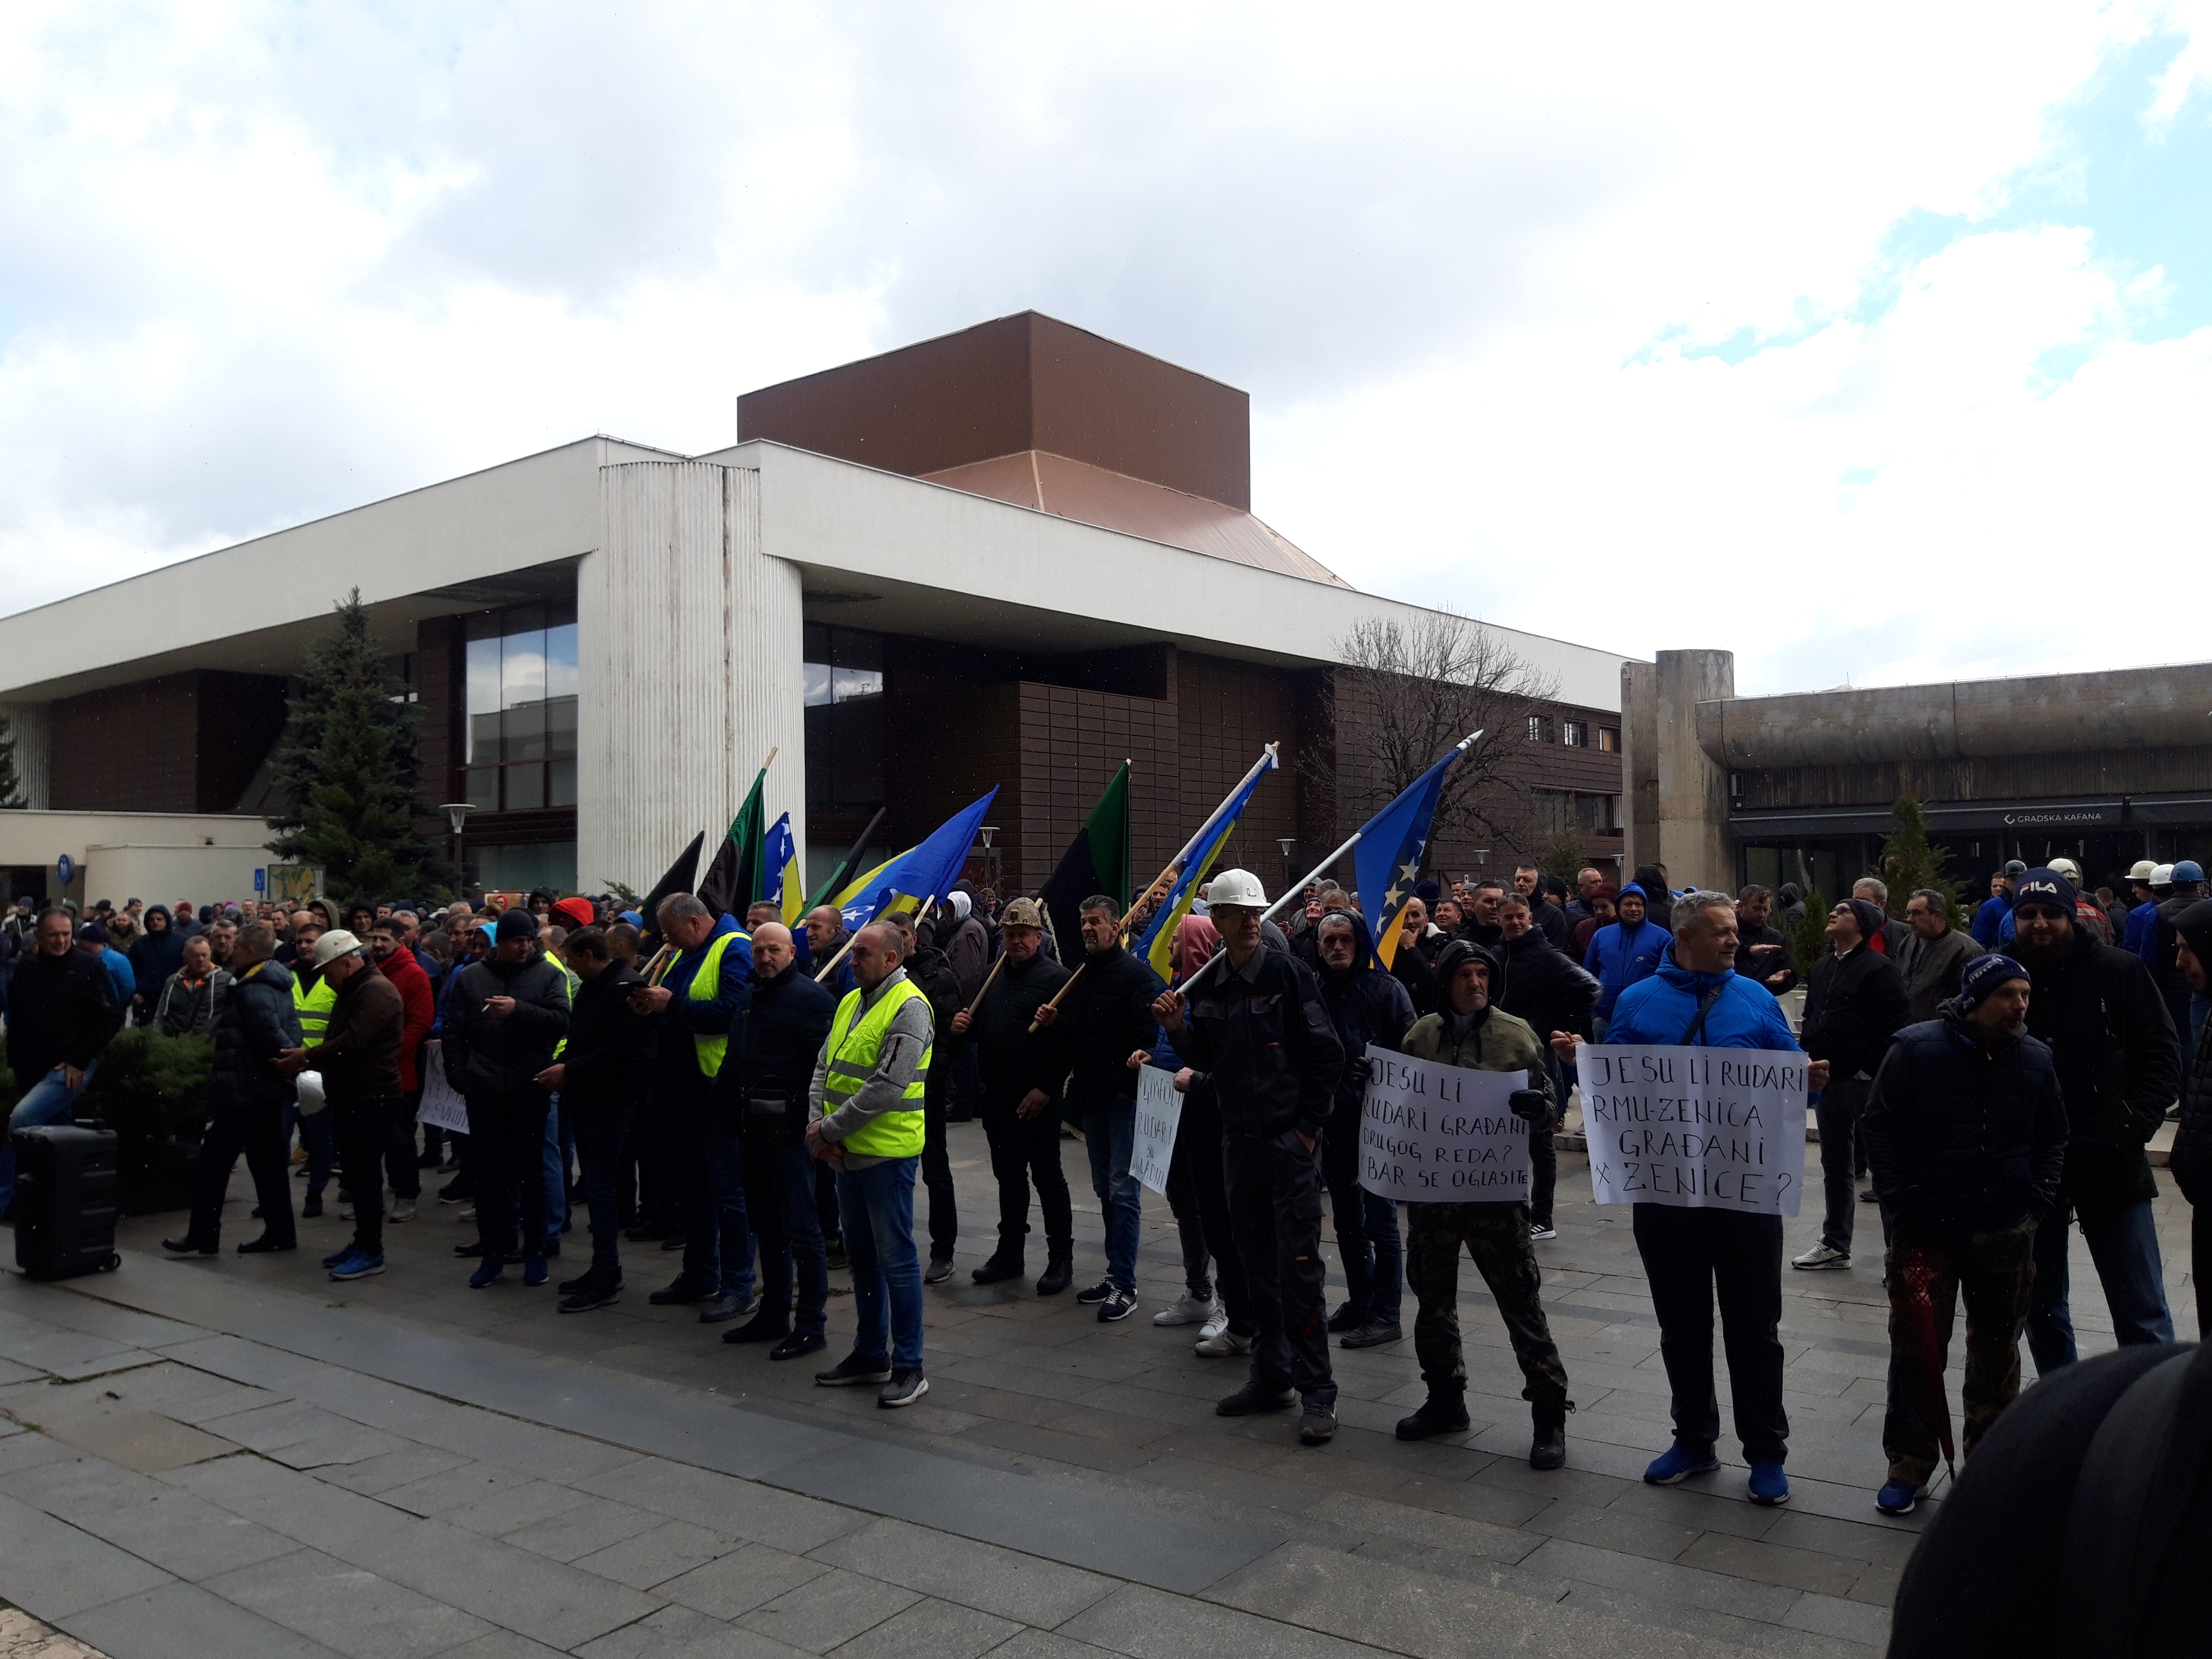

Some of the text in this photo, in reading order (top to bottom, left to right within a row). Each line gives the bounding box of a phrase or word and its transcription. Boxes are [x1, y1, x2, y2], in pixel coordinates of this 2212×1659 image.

[2017, 813, 2102, 823] GRADSKA KAFANA
[2020, 881, 2057, 896] FILA
[1371, 1057, 1426, 1096] JESU
[1591, 1056, 1674, 1086] JESU
[1721, 1060, 1803, 1092] RUDARI
[1362, 1093, 1426, 1132] RUDARI
[1592, 1095, 1763, 1129] RMU-ZENICA
[1364, 1127, 1512, 1164] DRUGOG REDA?
[1368, 1156, 1528, 1188] BAR SE OGLASITE
